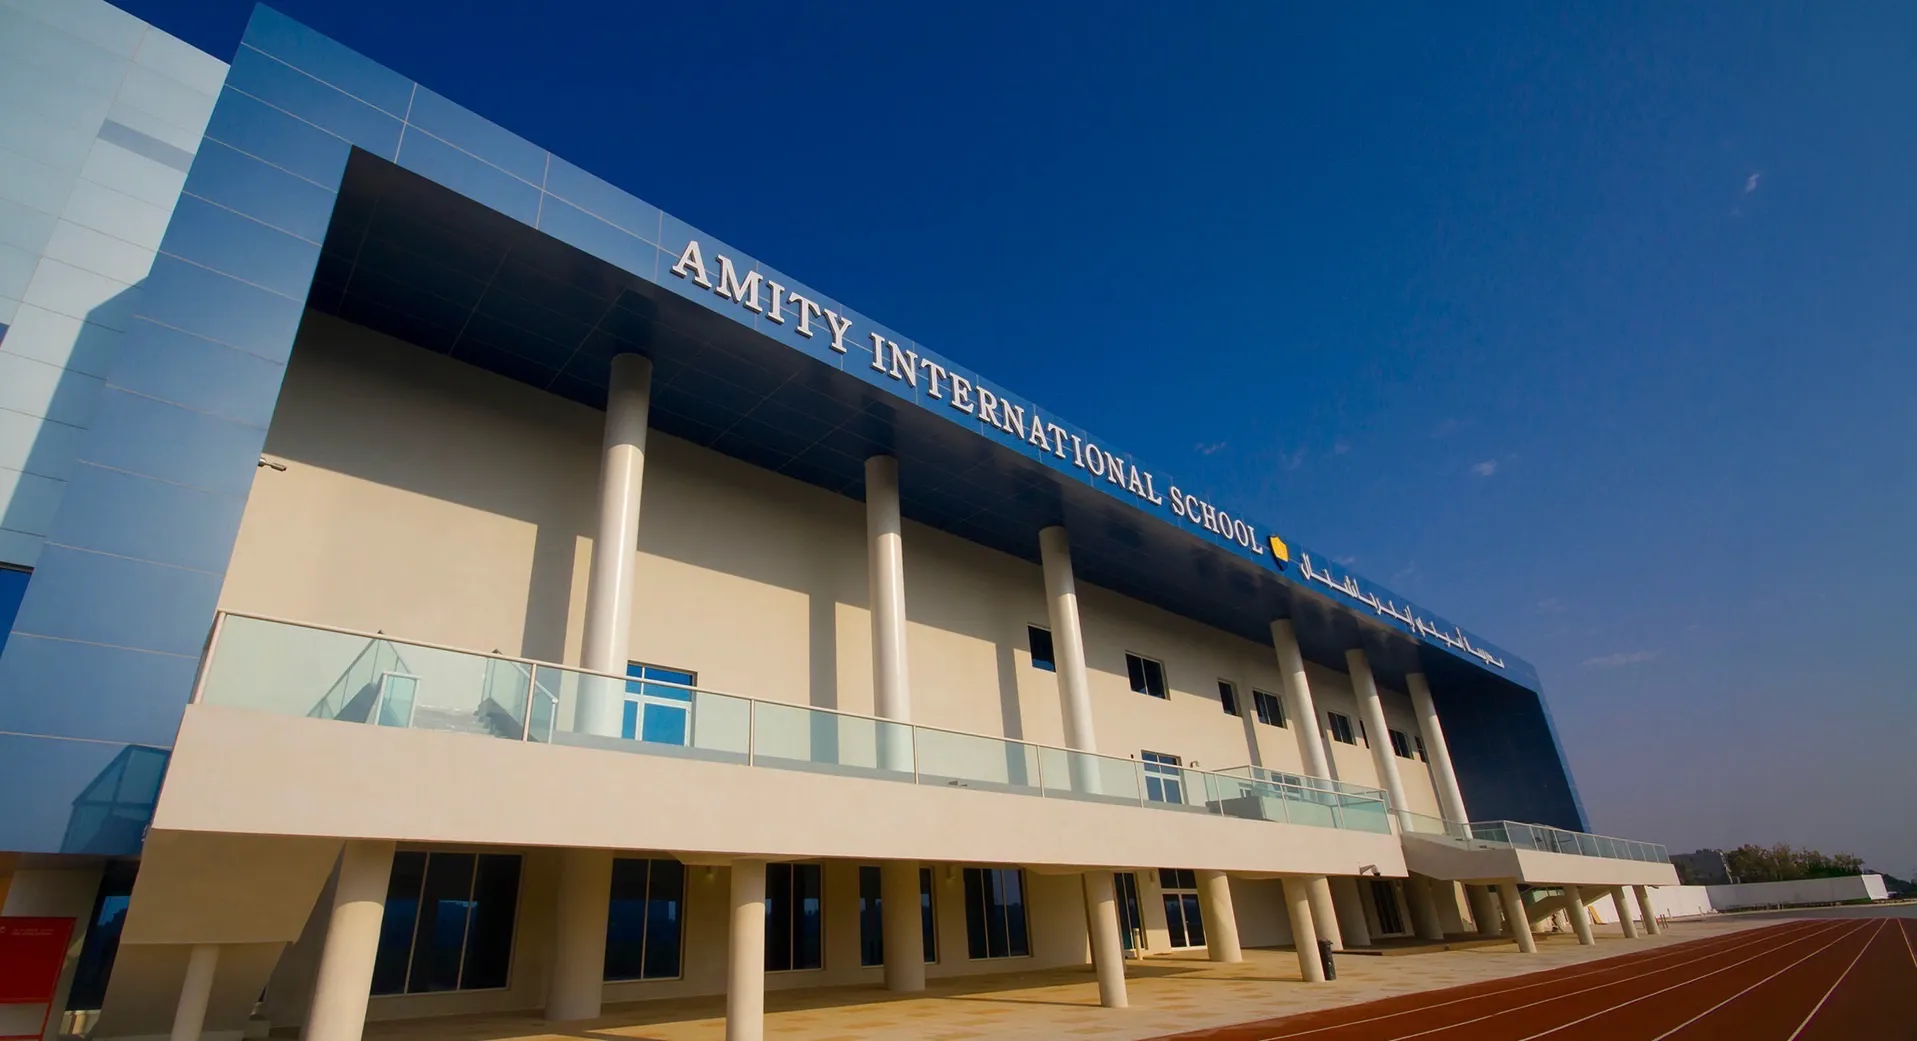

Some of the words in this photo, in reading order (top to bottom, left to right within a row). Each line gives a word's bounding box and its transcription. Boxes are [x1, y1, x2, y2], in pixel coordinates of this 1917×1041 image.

[671, 240, 853, 354] AMITY
[868, 331, 1162, 507] INTERNATIONAL
[1169, 485, 1265, 556] SCHOOL
